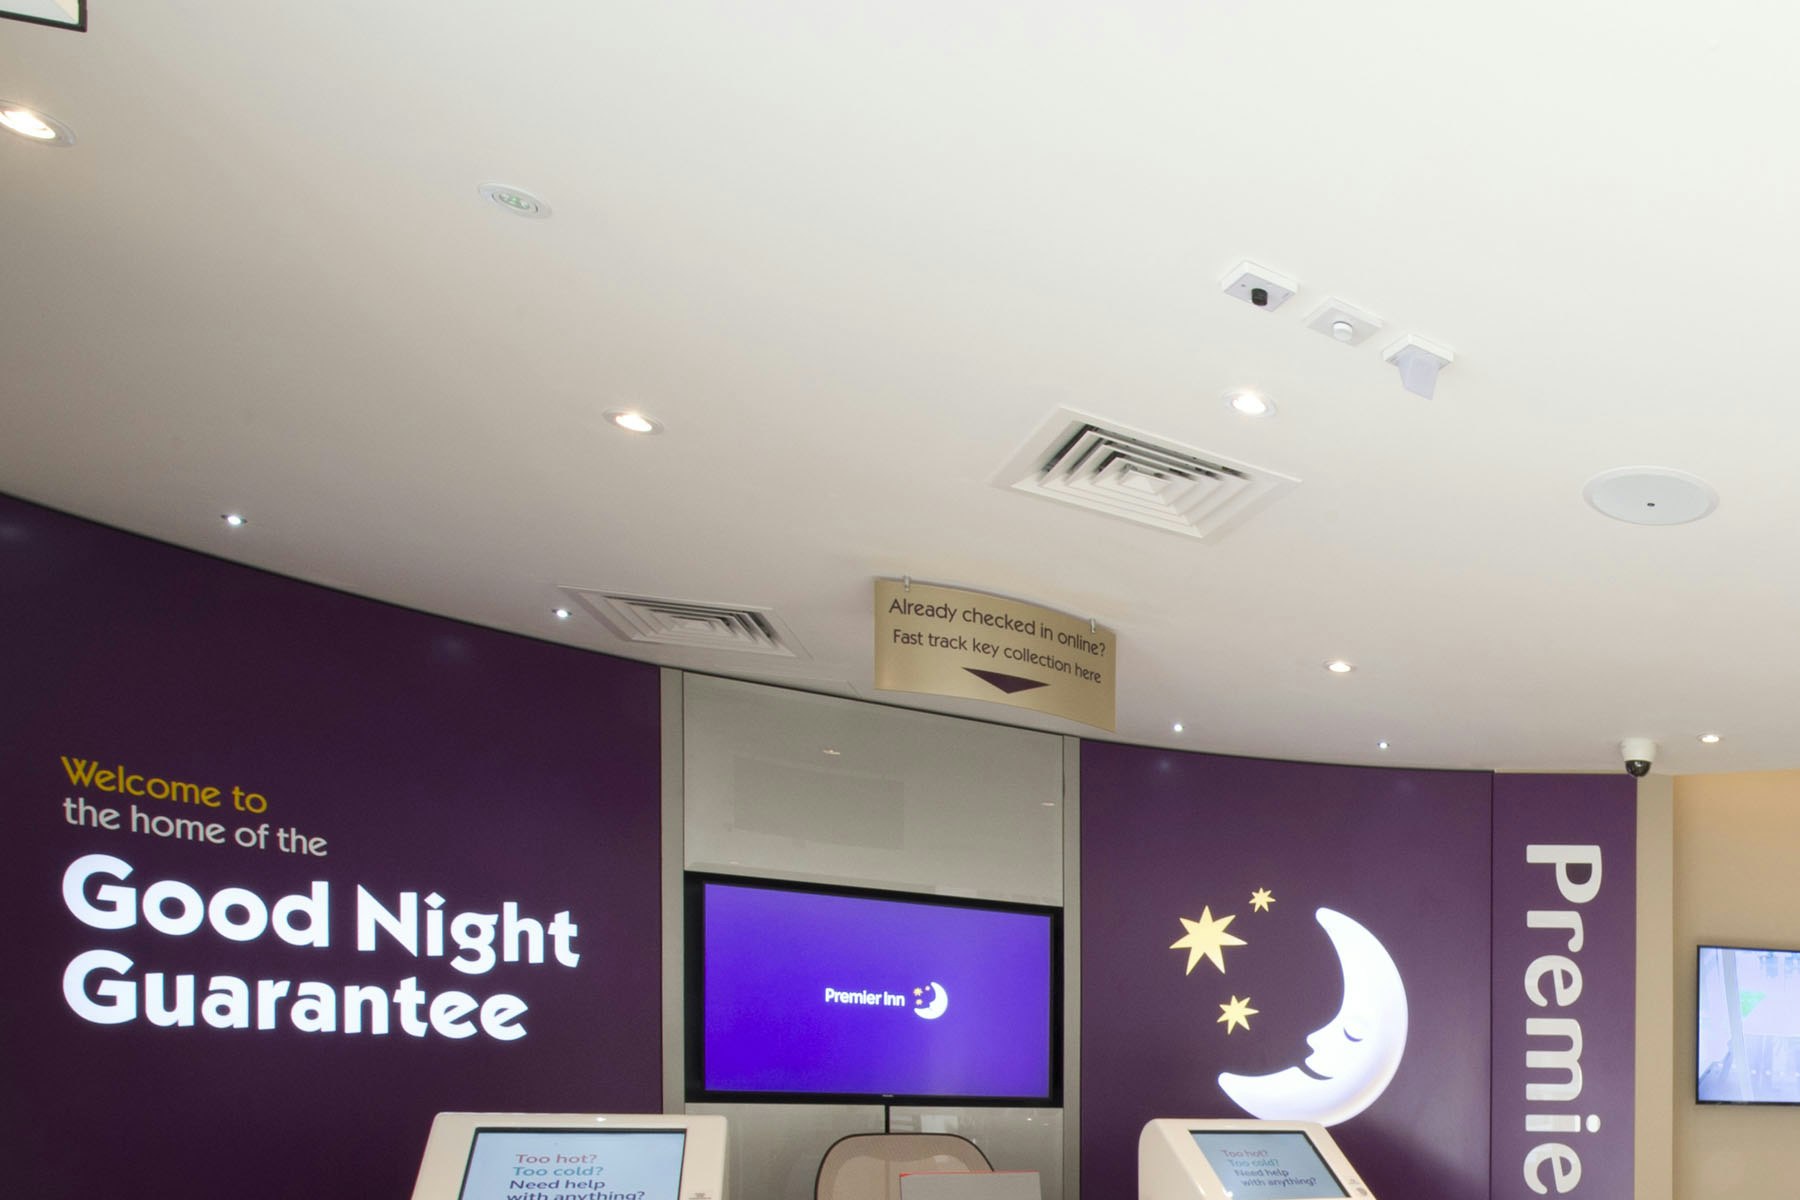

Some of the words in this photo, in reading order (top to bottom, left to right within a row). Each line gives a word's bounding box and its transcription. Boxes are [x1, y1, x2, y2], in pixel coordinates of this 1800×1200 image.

[889, 598, 957, 622] Already
[962, 607, 1036, 635] checked
[1040, 623, 1053, 640] in
[1058, 631, 1105, 656] online?
[893, 629, 924, 646] Fast
[928, 632, 967, 650] track
[973, 638, 1000, 658] key
[1004, 646, 1071, 674] collection
[1075, 662, 1101, 684] here
[61, 755, 221, 807] Welcome
[232, 786, 267, 813] to
[63, 797, 120, 830] the
[131, 805, 226, 844] home
[234, 824, 270, 849] of
[276, 827, 327, 856] the
[62, 853, 329, 947] Good
[356, 883, 580, 974] Night
[62, 949, 529, 1041] Guarantee
[825, 987, 882, 1005] Premier
[884, 991, 905, 1006] Inn
[509, 1180, 560, 1189] Need
[564, 1180, 606, 1192] help
[513, 1167, 548, 1176] Too
[553, 1166, 604, 1176] cold?
[515, 1154, 551, 1164] Too
[556, 1154, 598, 1164] hot?
